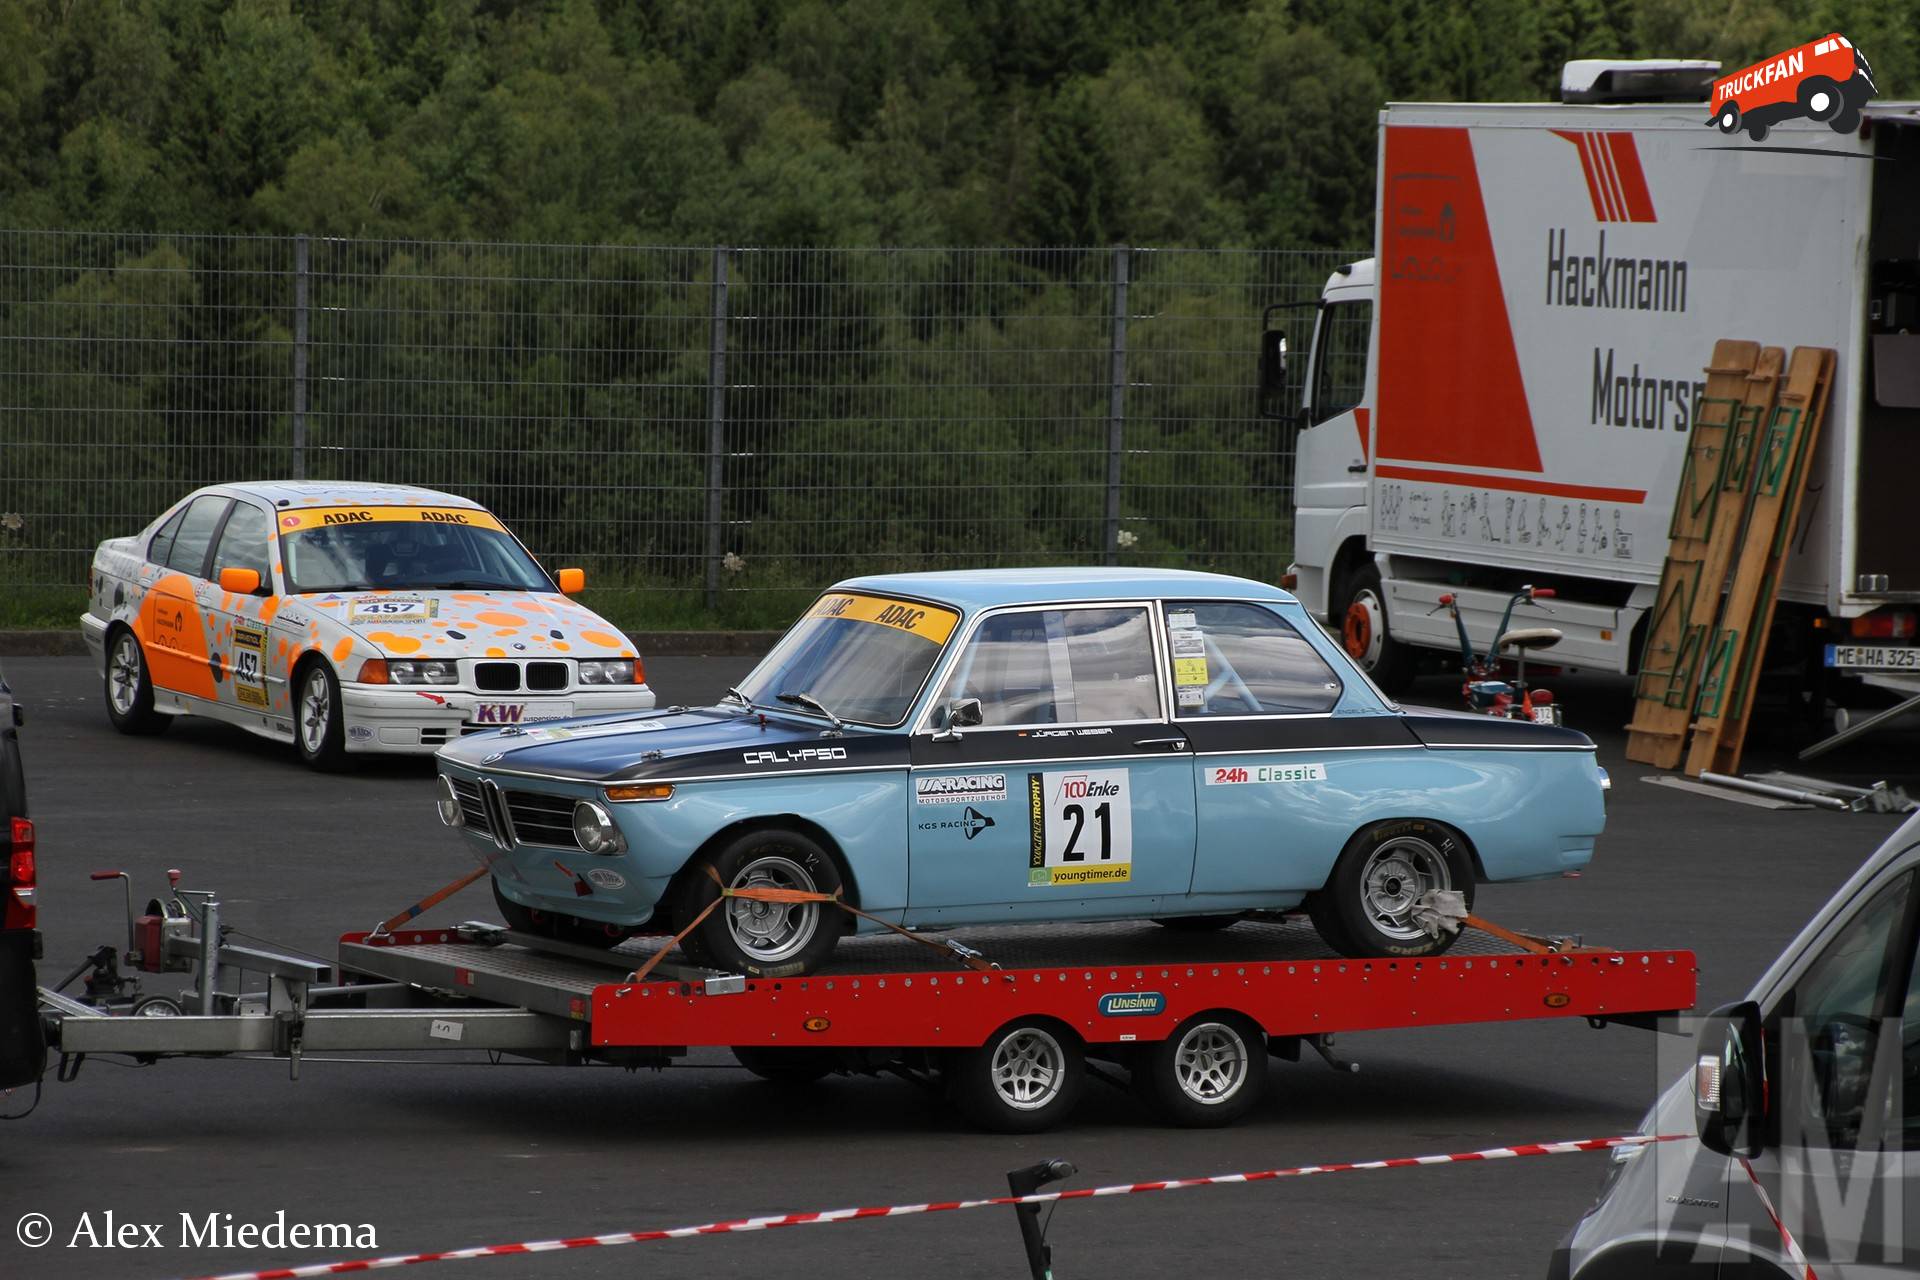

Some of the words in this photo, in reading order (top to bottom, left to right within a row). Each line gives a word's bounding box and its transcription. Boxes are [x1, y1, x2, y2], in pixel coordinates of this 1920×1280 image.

[1546, 228, 1687, 312] Hackmann
[323, 511, 373, 525] ADAC
[421, 511, 469, 524] ADAC
[363, 603, 415, 613] 457
[817, 598, 854, 617] ADAC
[874, 604, 926, 630] ADAC
[1837, 647, 1855, 665] ME
[1865, 649, 1884, 665] HA
[237, 651, 257, 683] 457
[477, 704, 525, 722] KW
[1032, 729, 1075, 738] JÜRGEN
[1076, 727, 1113, 736] WEBER
[743, 747, 847, 764] CALYPSO
[1215, 768, 1248, 783] 24h
[1258, 766, 1317, 782] Classic
[918, 822, 938, 830] KGS
[940, 820, 977, 829] RACING
[1063, 802, 1111, 862] 21
[1054, 867, 1127, 883] youngtimer.de
